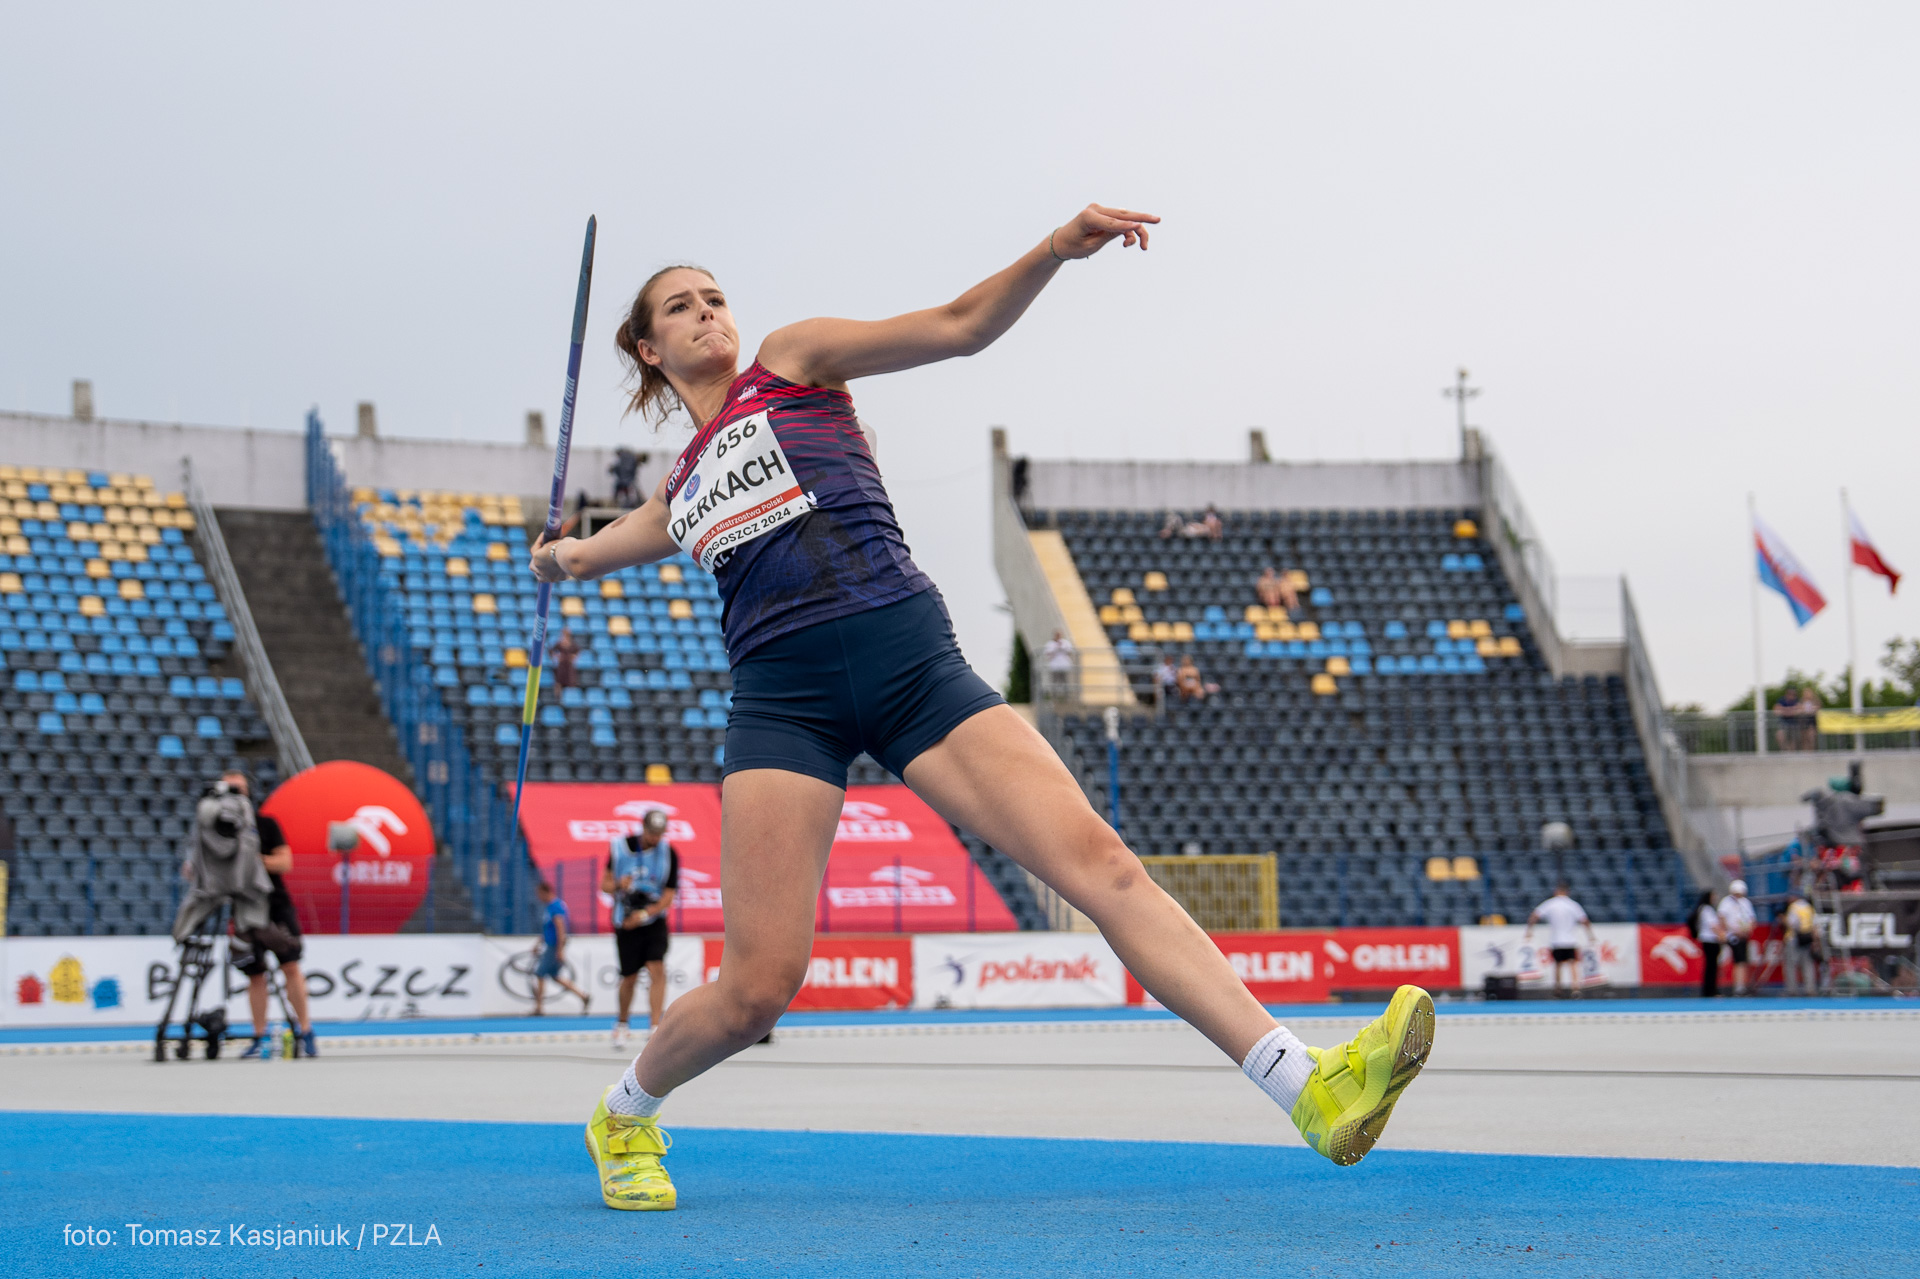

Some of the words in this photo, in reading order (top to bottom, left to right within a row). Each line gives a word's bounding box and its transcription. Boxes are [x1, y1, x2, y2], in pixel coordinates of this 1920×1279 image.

[717, 419, 757, 459] 656
[671, 449, 785, 543] DERKACH
[716, 508, 761, 532] Mistrzostwa
[761, 495, 784, 511] Polski
[703, 522, 760, 566] BYDGOSZCZ
[761, 507, 791, 528] 2024
[802, 957, 899, 988] RLEN
[977, 953, 1098, 991] polanik
[1227, 952, 1314, 982] RLEN
[1352, 943, 1449, 972] ORLEN
